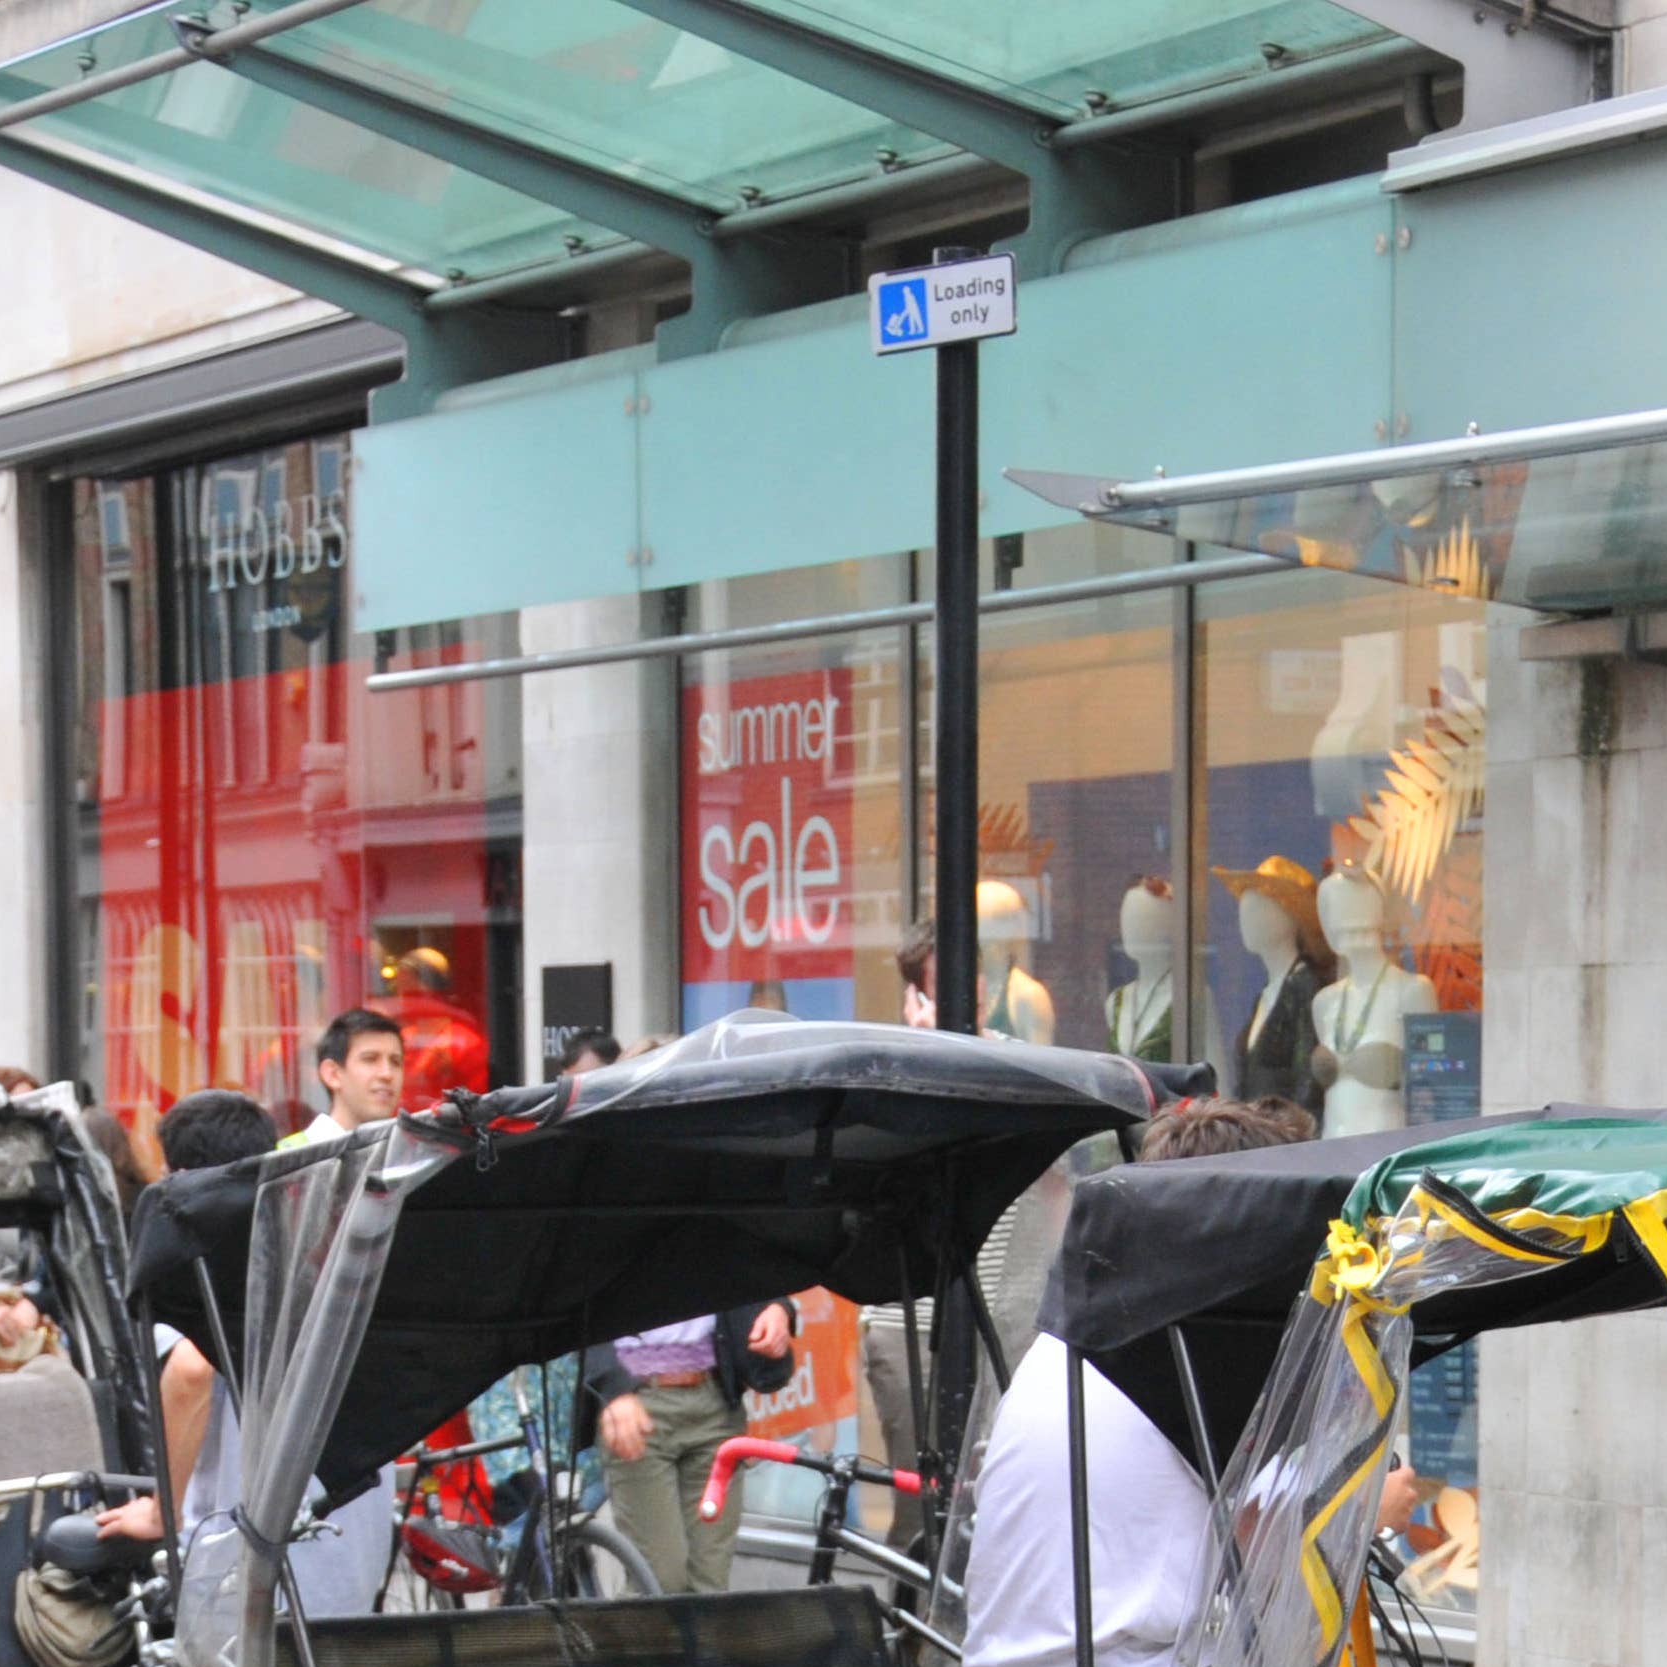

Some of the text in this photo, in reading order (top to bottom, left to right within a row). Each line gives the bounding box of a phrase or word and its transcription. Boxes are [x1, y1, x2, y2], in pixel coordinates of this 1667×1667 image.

[934, 277, 1006, 302] Loading
[951, 303, 989, 325] only
[209, 489, 348, 593] HOBBS
[697, 698, 840, 774] summer
[699, 776, 840, 949] sale
